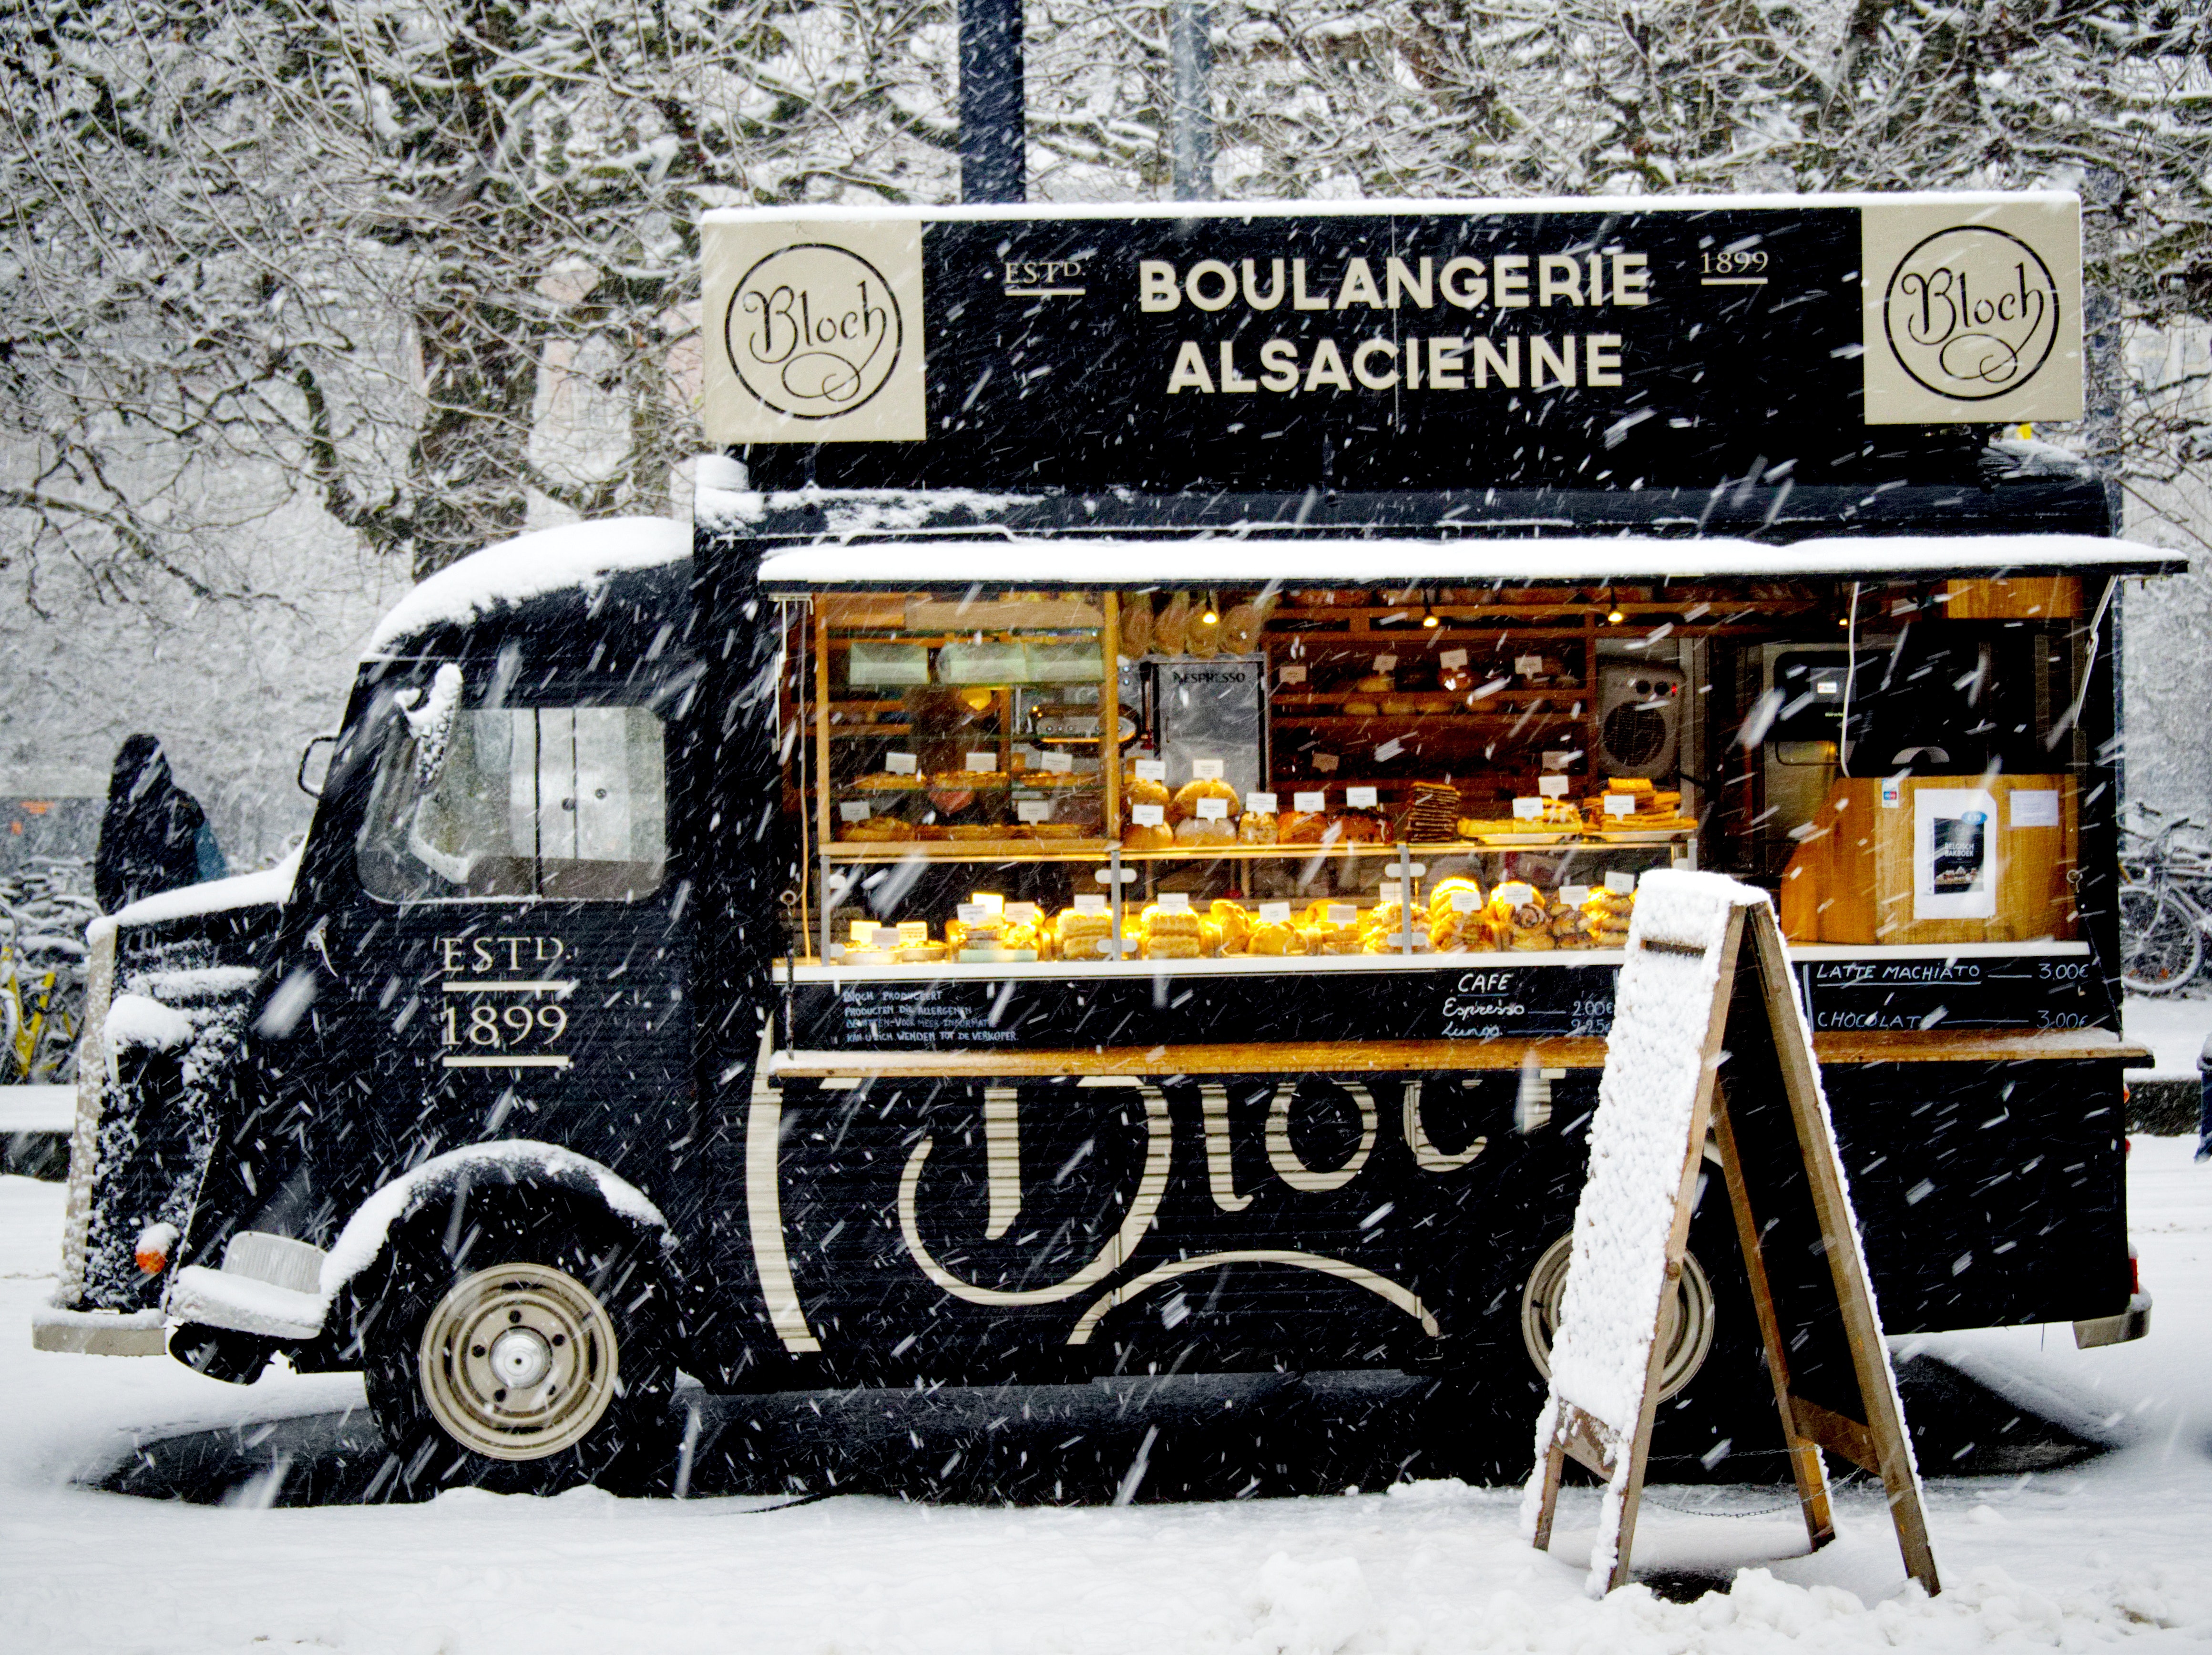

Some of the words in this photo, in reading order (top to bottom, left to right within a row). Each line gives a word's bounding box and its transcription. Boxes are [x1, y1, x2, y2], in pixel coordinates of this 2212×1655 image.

[1700, 251, 1769, 273] 1899
[1138, 253, 1649, 313] BOULANGERIE
[1901, 262, 2045, 384] Bloch
[743, 280, 888, 403] Bloch
[1166, 333, 1622, 394] ALSACIENNE
[1172, 671, 1246, 684] NESPRESSO
[1458, 973, 1514, 993] CAFE
[1816, 963, 1876, 979] LATTE
[1882, 963, 1980, 980] MACHIATO
[1442, 997, 1525, 1021] Espresso
[441, 1005, 568, 1045] 1899
[896, 1030, 936, 1042] WENDEN
